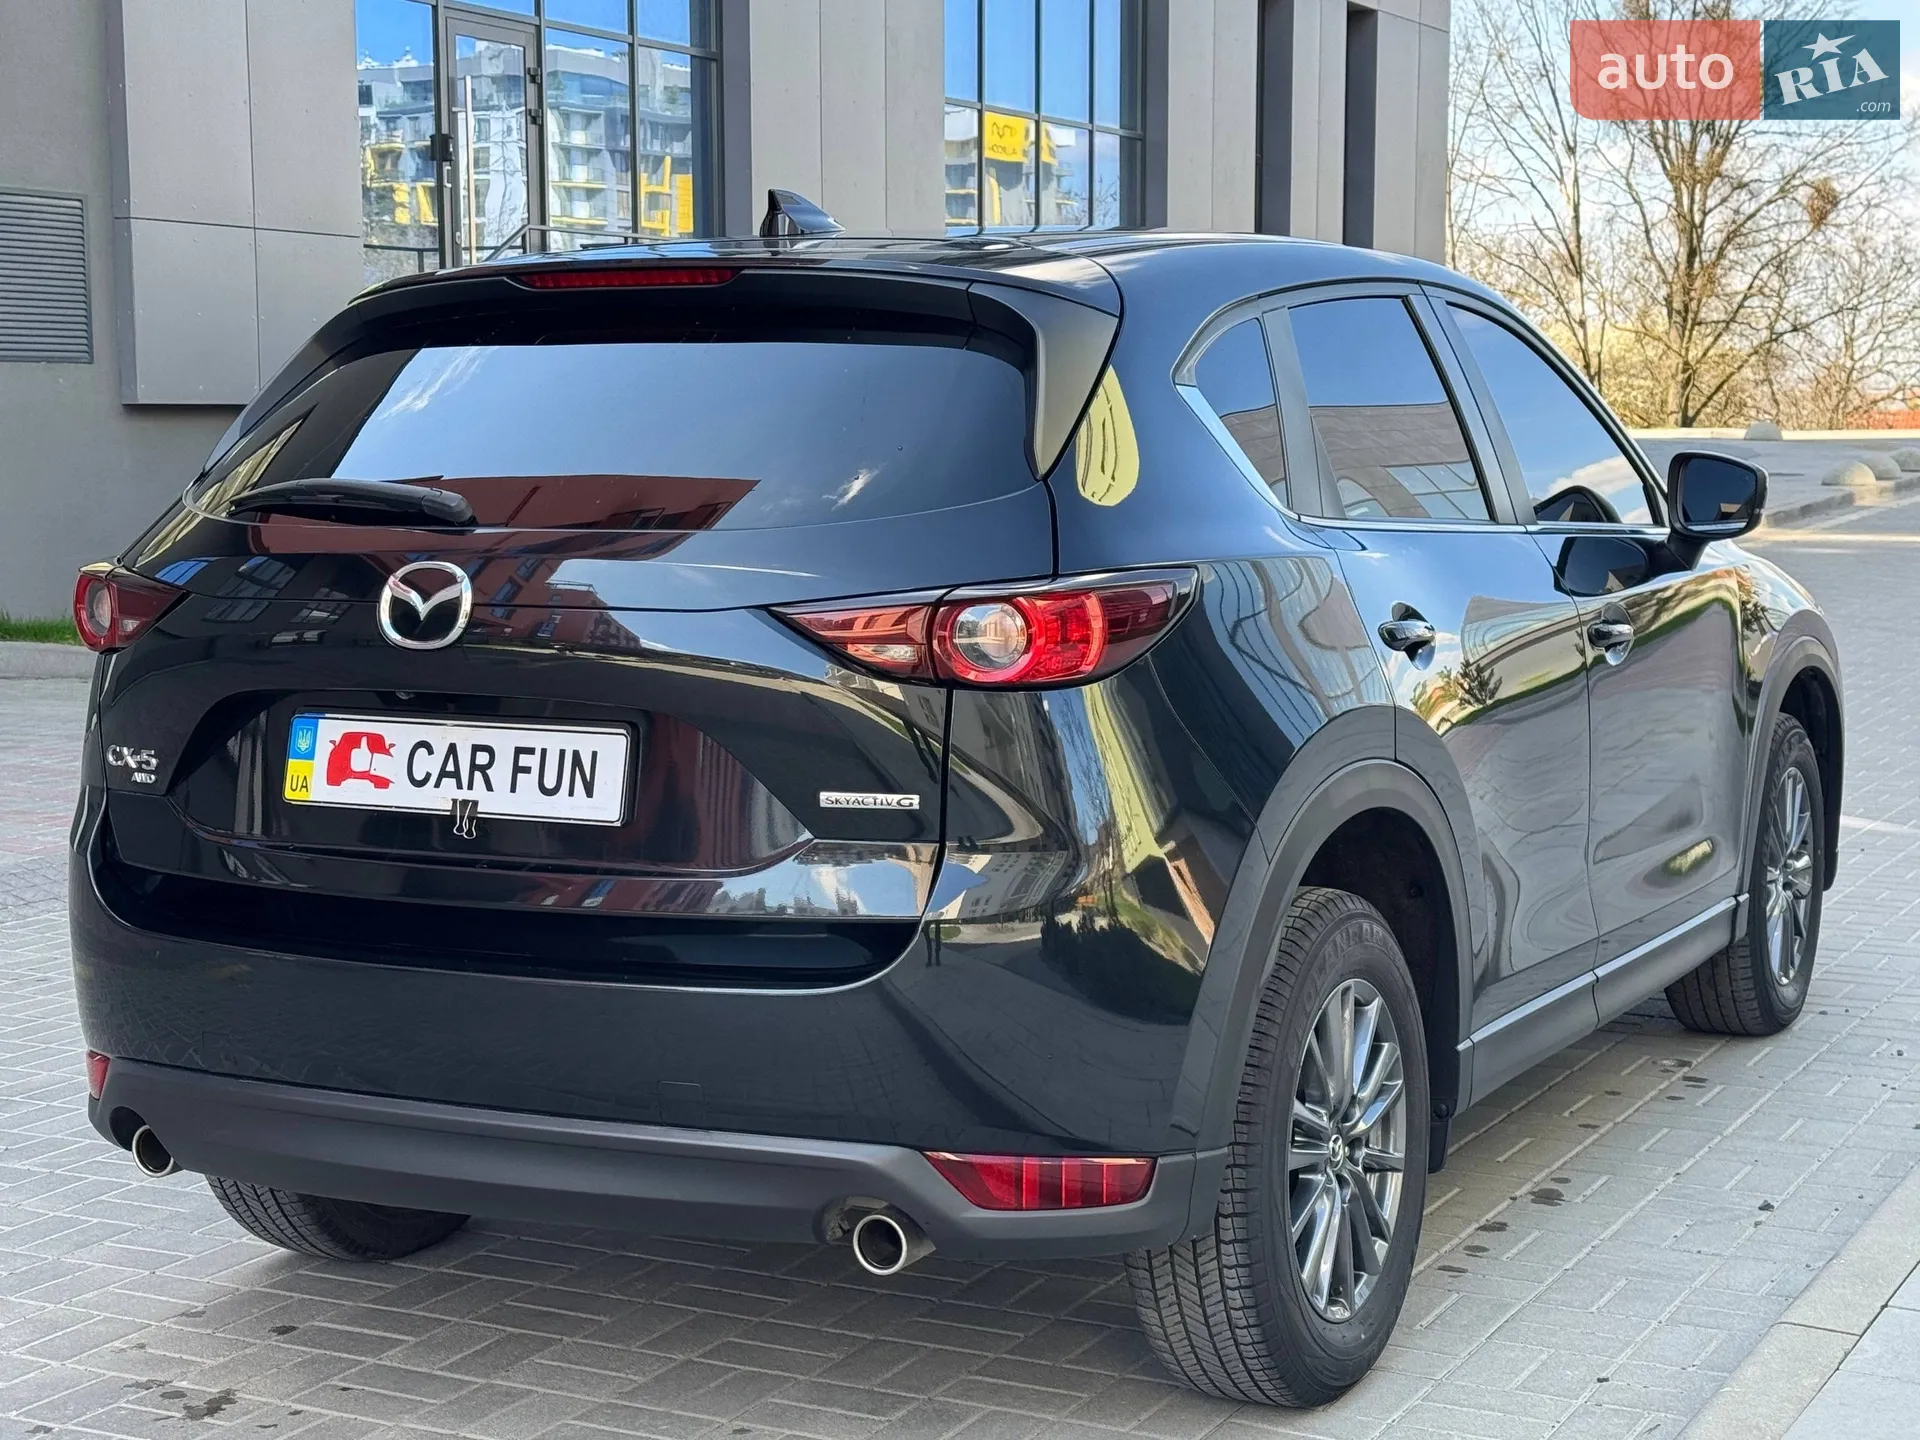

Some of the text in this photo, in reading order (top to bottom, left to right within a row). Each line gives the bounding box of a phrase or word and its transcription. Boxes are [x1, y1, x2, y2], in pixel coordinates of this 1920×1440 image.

[106, 744, 159, 771] CX-5
[406, 739, 599, 799] CAR FUN
[290, 774, 309, 793] UA
